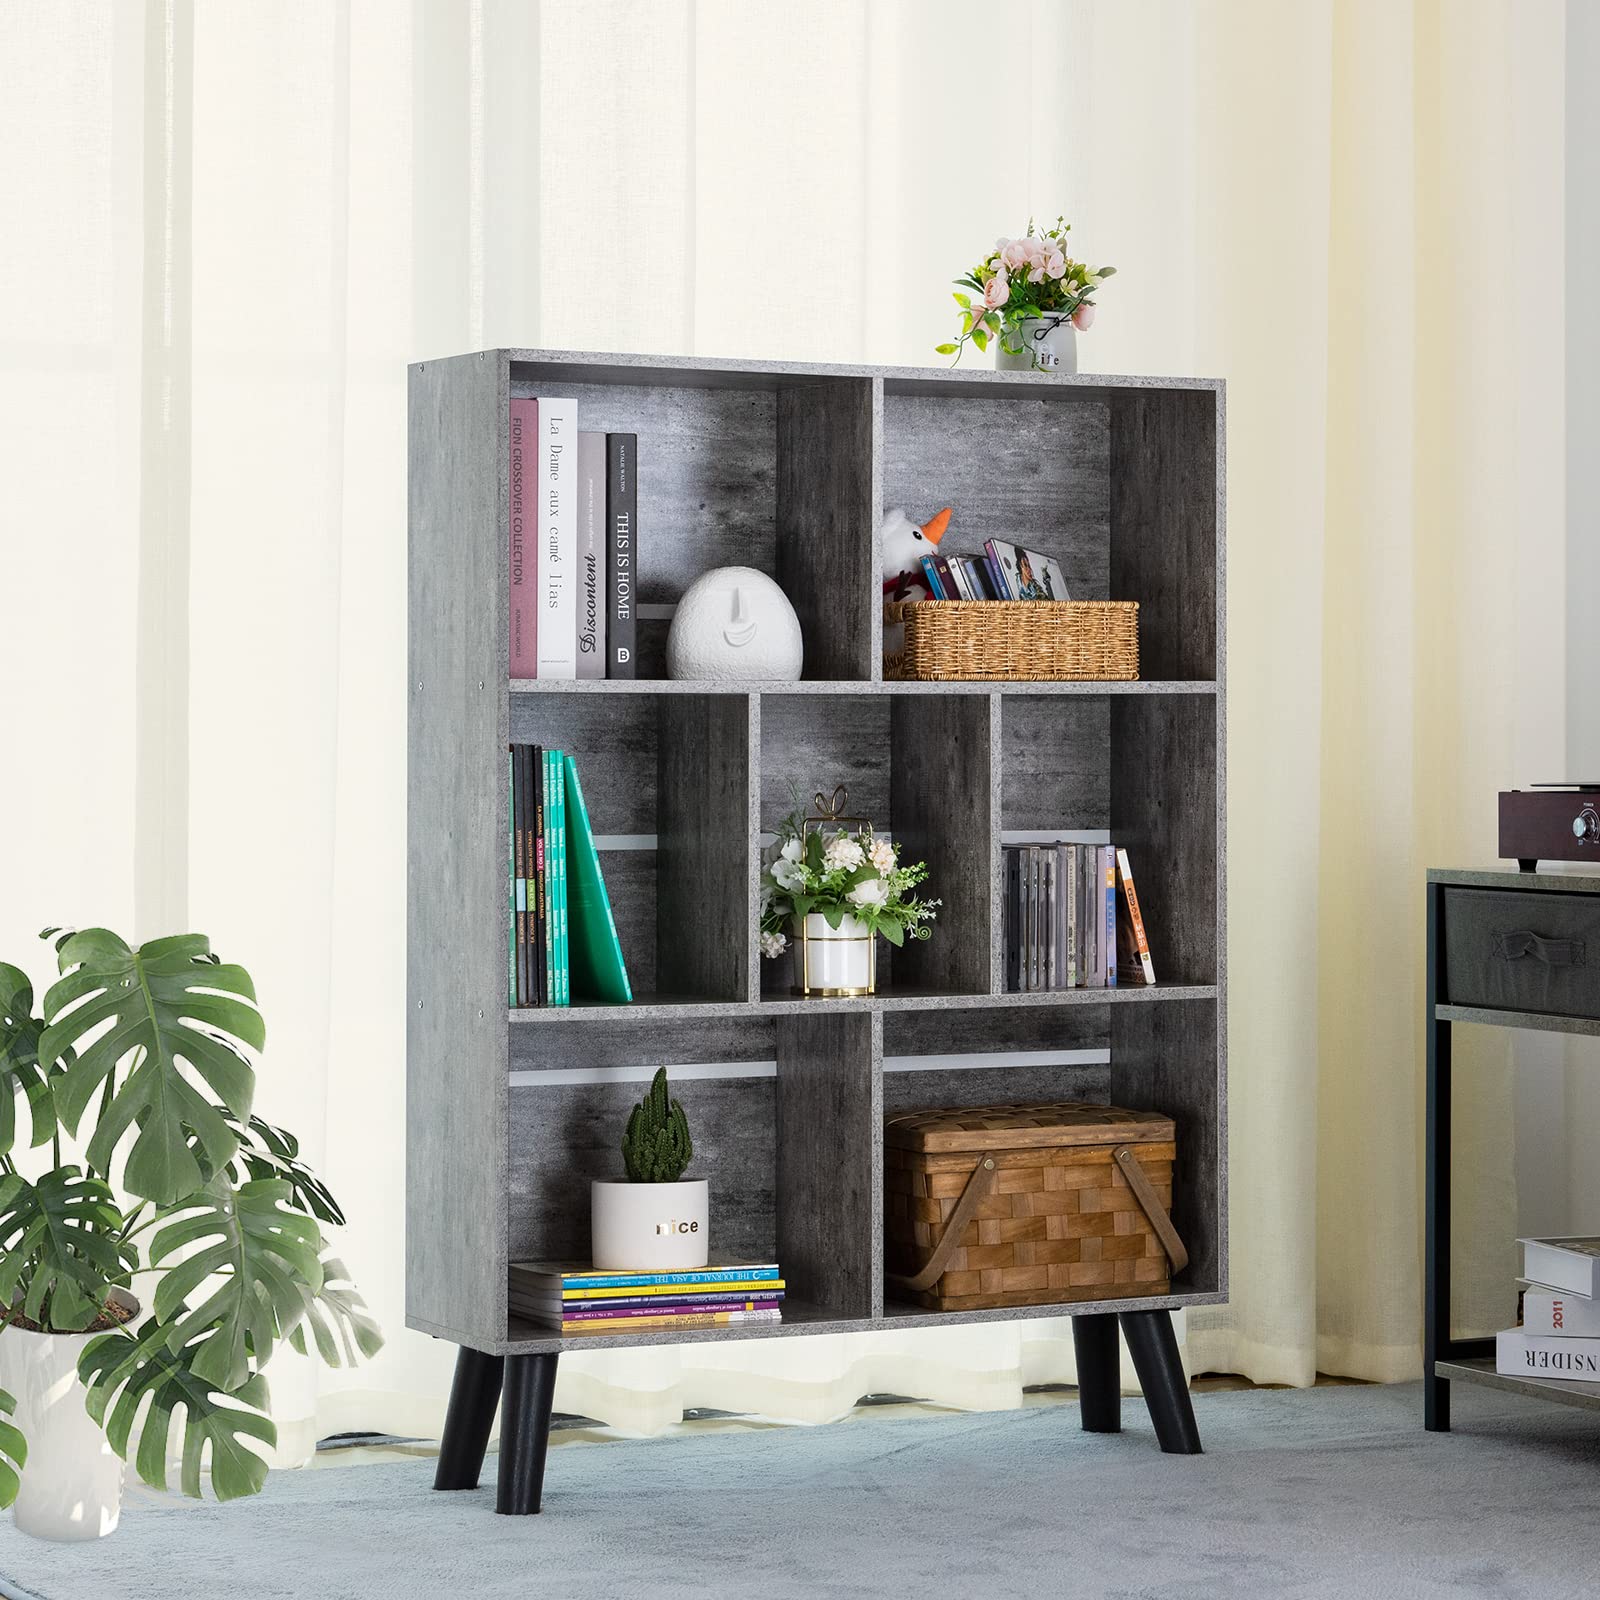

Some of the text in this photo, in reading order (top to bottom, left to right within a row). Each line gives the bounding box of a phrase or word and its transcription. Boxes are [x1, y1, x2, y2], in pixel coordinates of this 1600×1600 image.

[1034, 353, 1060, 366] ife
[512, 417, 522, 585] FION CROSSOVER COLLECTION
[550, 418, 563, 609] La Dame aux camé lias
[617, 512, 630, 620] THIS IS HOME
[578, 553, 596, 653] Discontent
[656, 1220, 698, 1235] nice
[702, 1272, 734, 1281] JOURNAL
[1552, 1301, 1563, 1328] 2011
[1524, 1350, 1598, 1371] NSIDER
